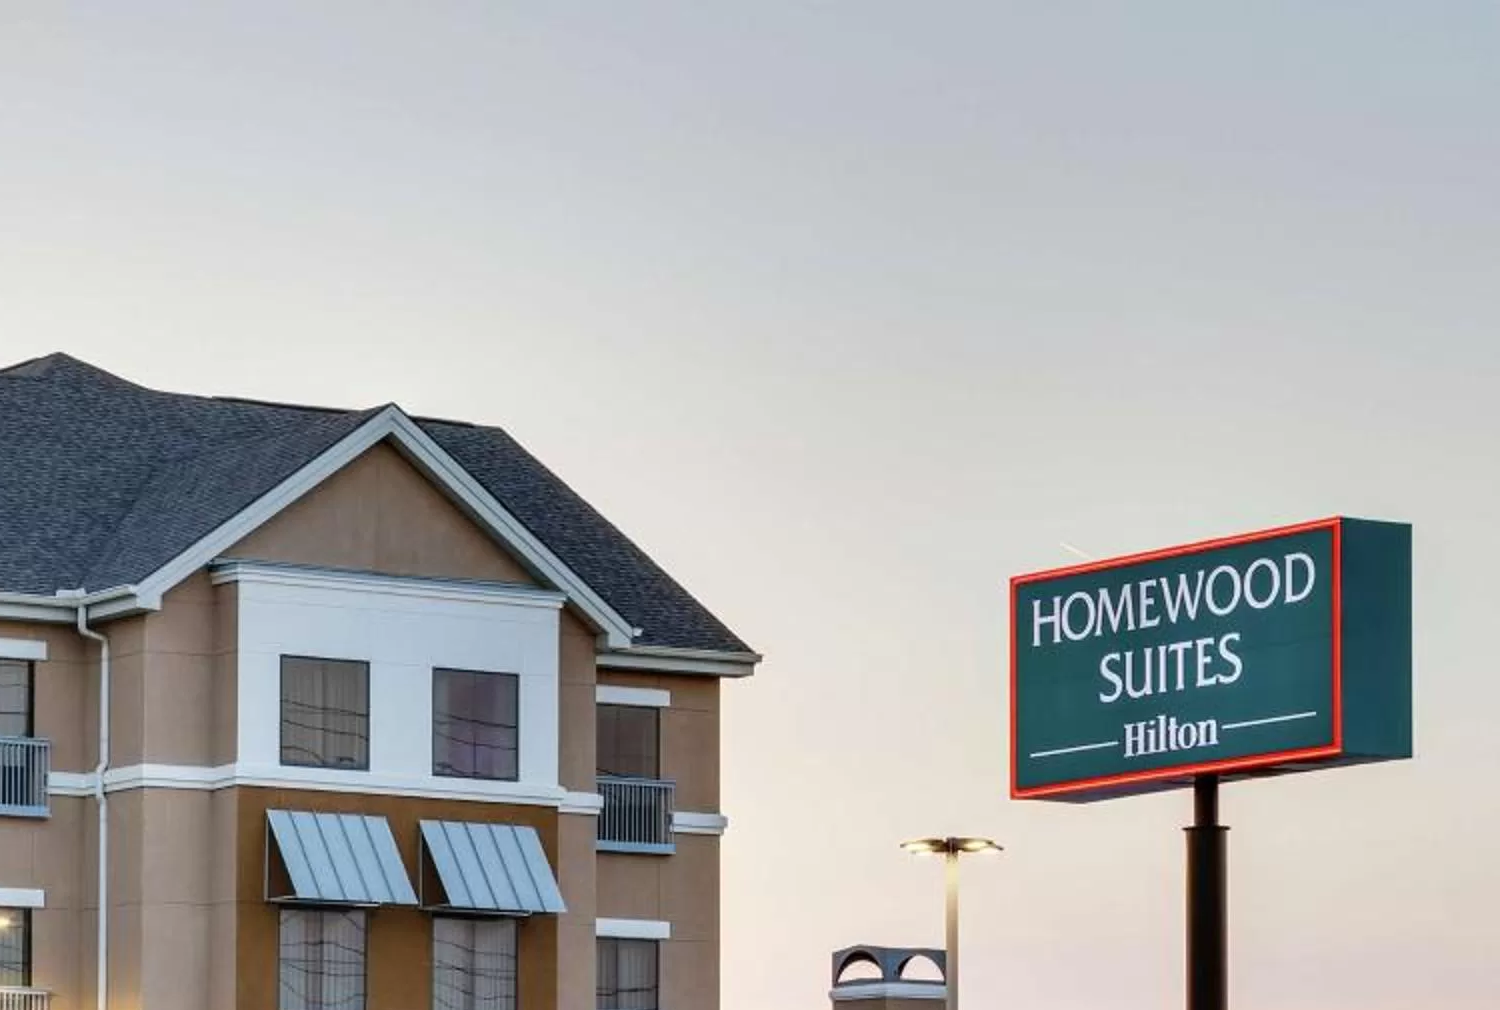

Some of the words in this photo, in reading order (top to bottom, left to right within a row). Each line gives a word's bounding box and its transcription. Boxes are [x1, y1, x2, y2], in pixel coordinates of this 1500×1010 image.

[1032, 552, 1316, 647] HOMEWOOD
[1099, 632, 1243, 703] SUITES
[1123, 714, 1219, 758] Hilton
